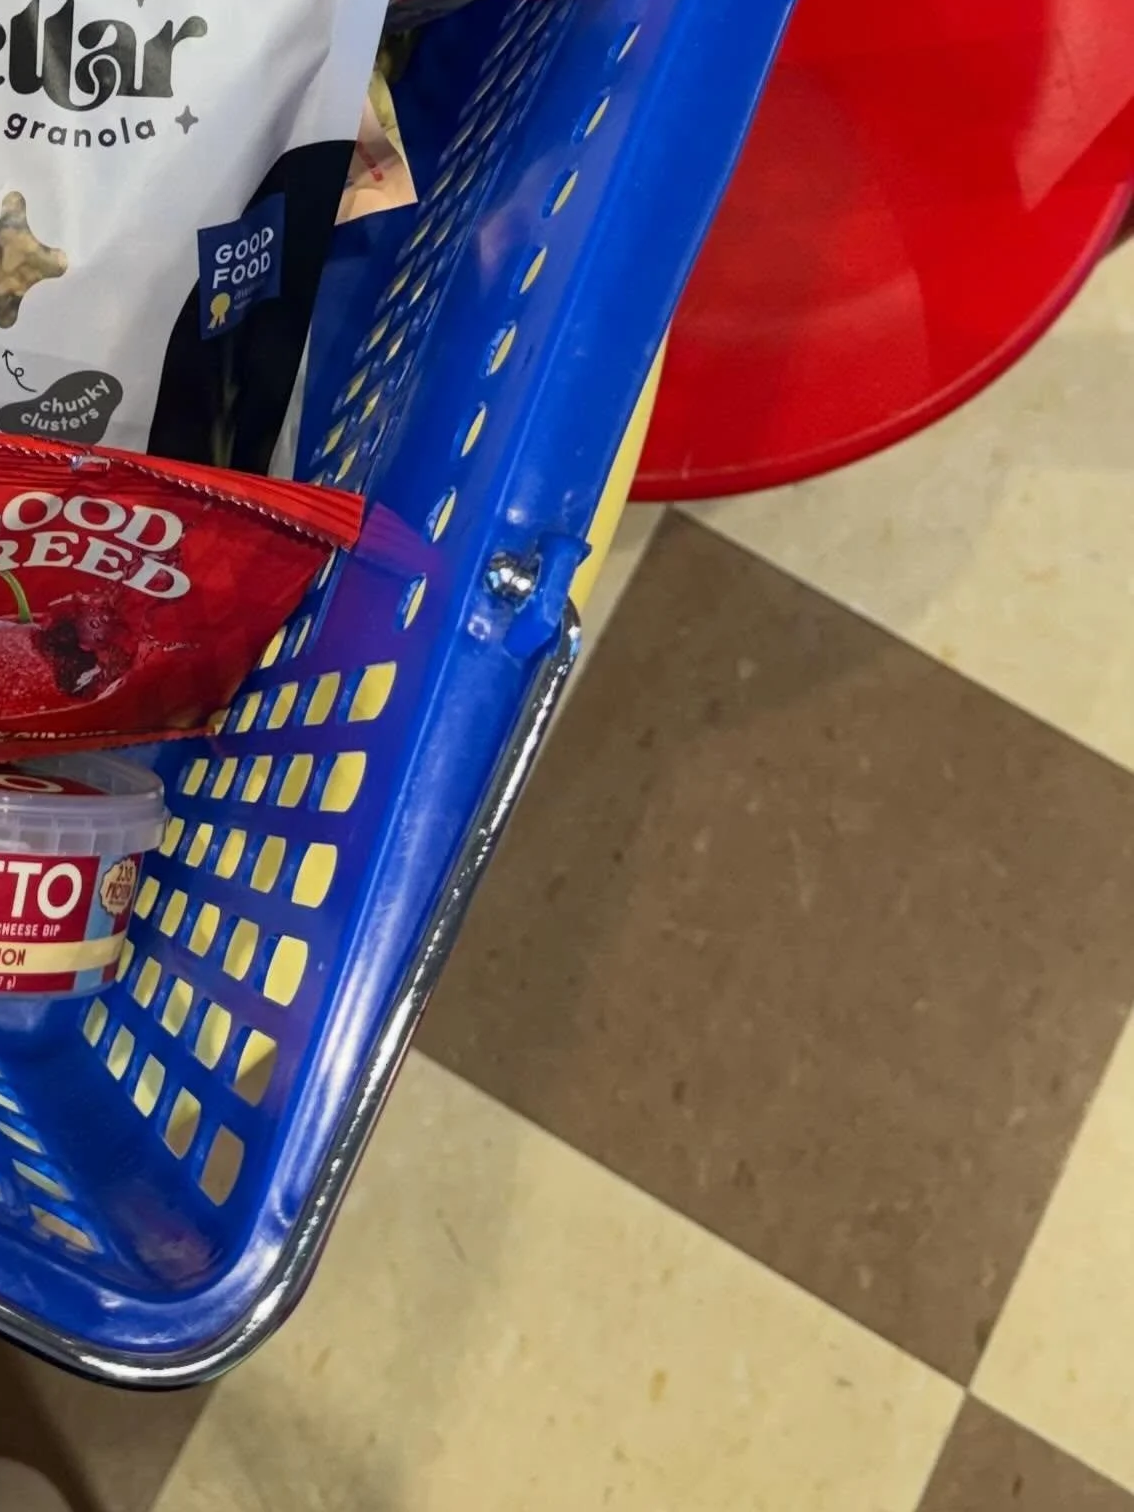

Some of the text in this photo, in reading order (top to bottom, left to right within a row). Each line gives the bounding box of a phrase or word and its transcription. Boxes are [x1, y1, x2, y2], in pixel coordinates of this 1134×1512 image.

[3, 111, 157, 149] granola
[215, 226, 274, 264] GOOD
[212, 251, 271, 289] FOOD
[39, 377, 111, 416] chunky
[19, 405, 101, 434] clusters
[42, 924, 61, 938] DIP
